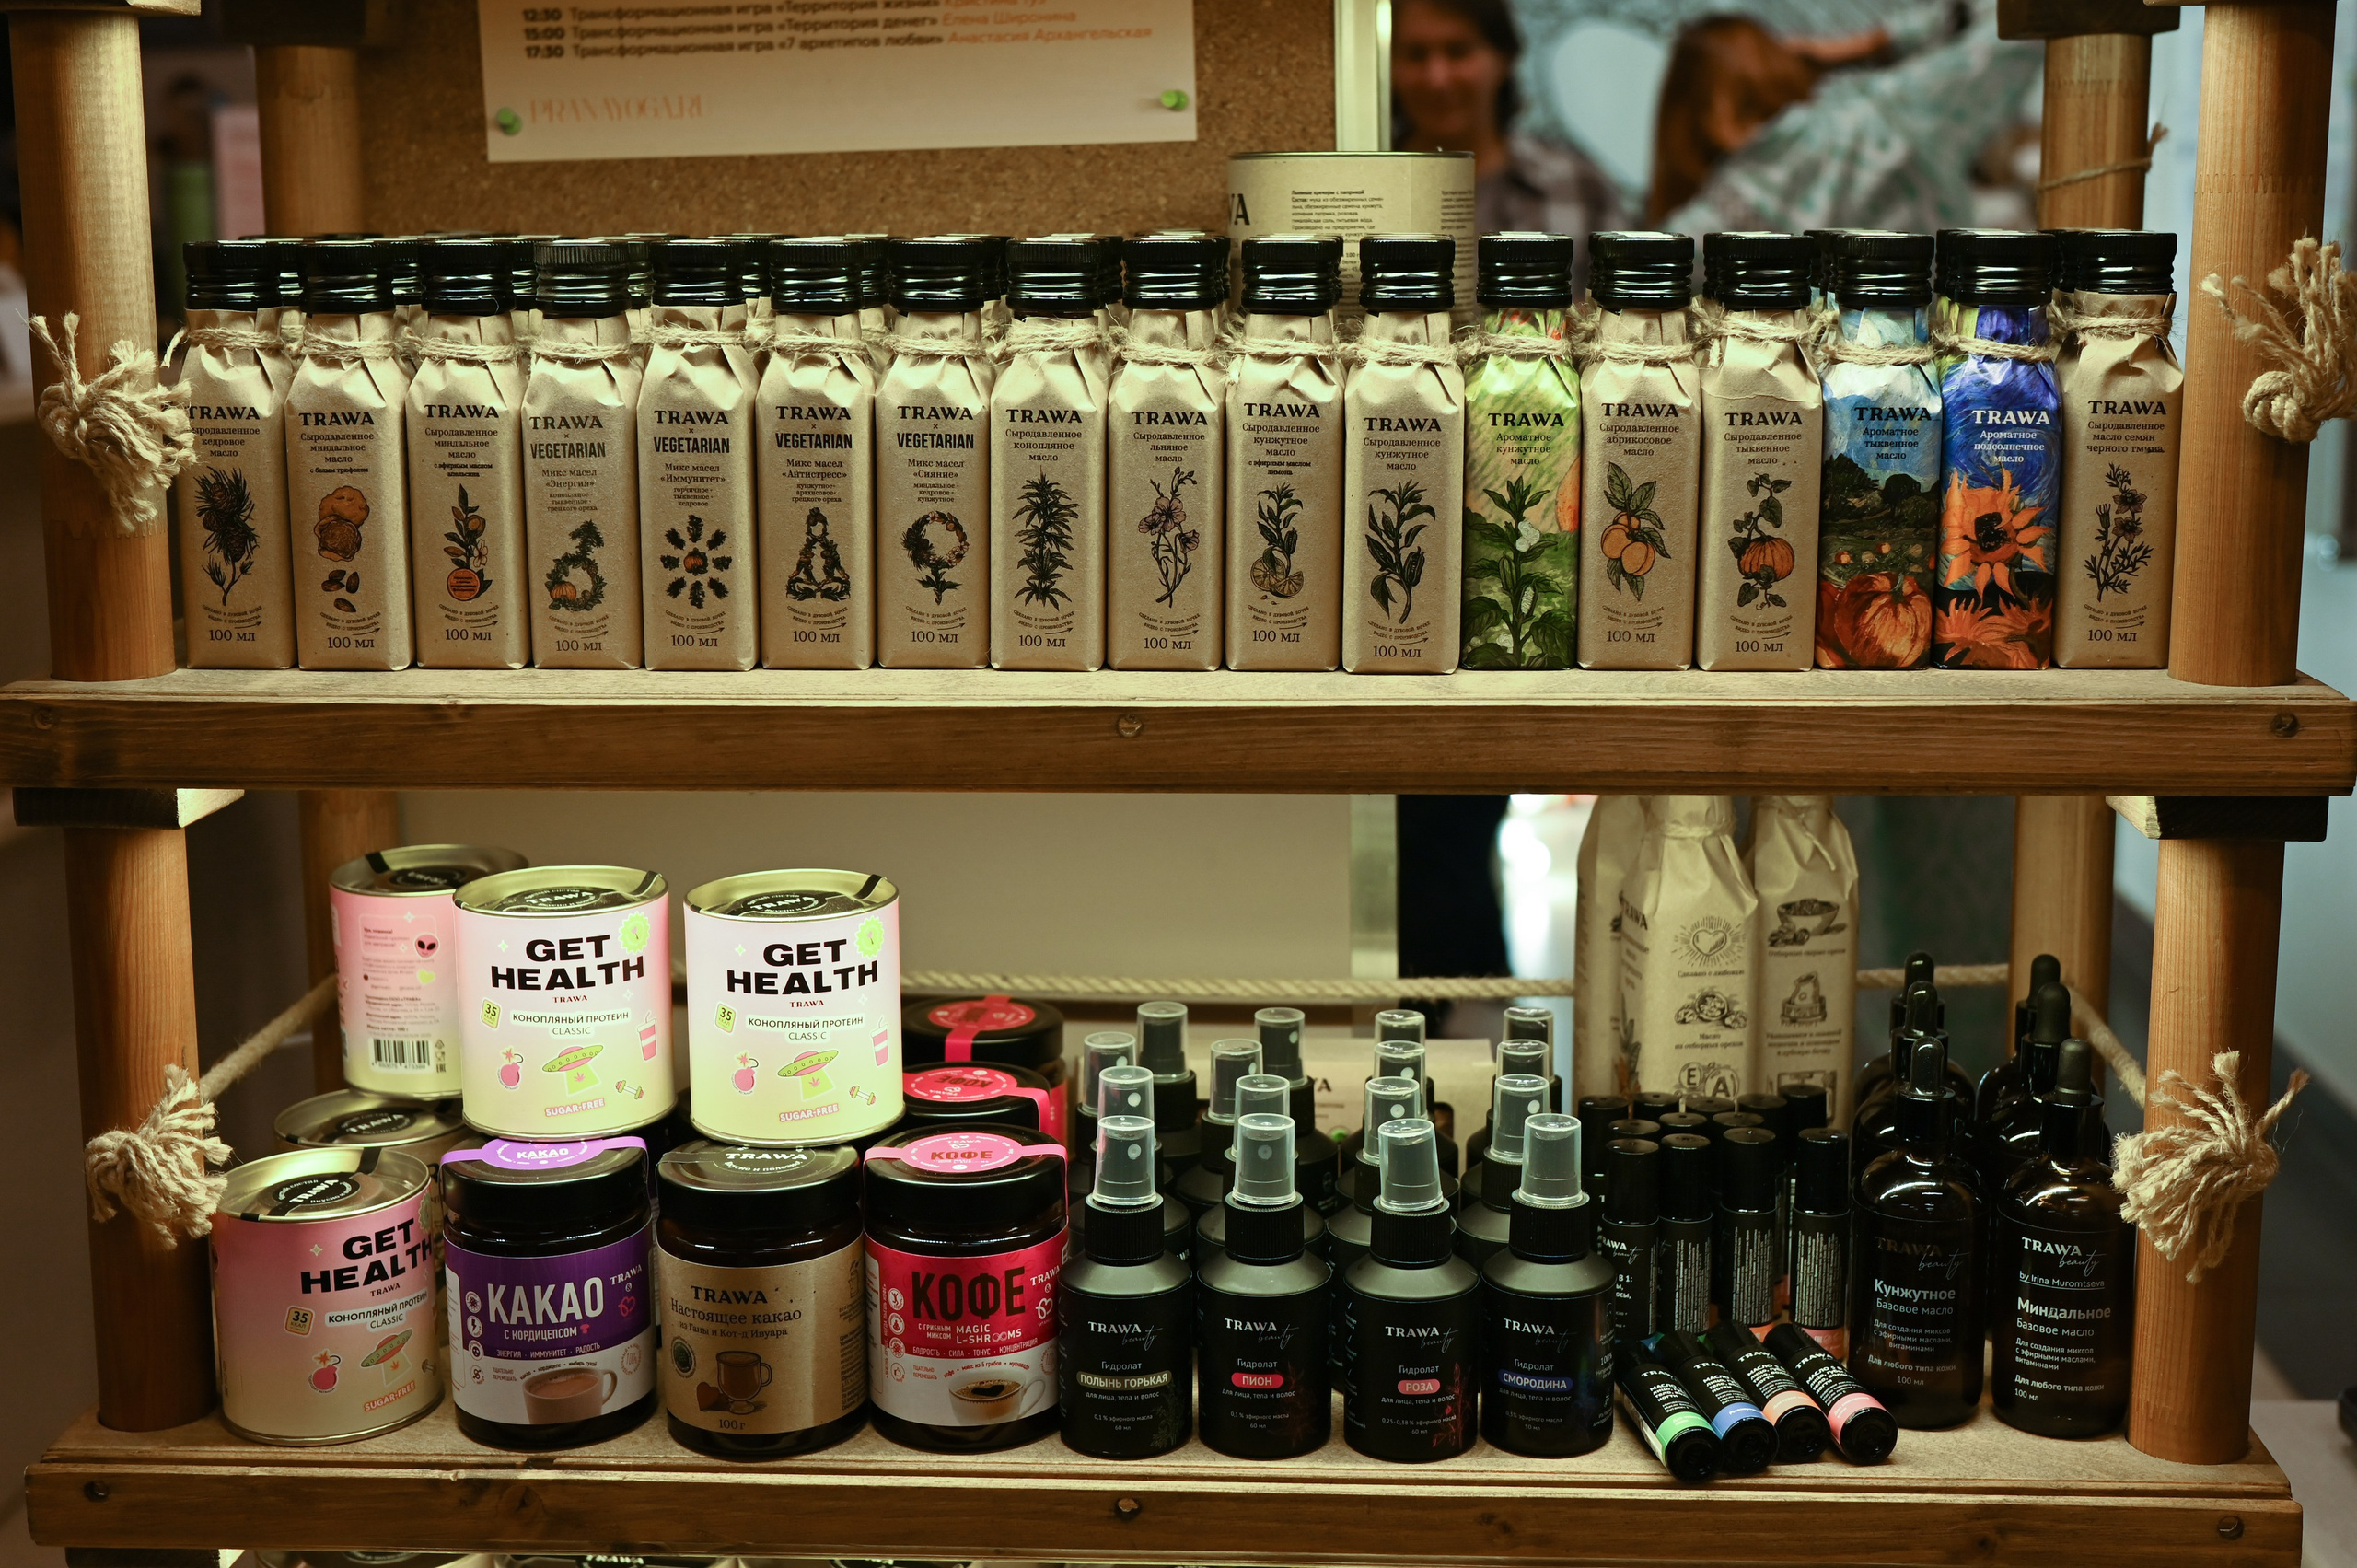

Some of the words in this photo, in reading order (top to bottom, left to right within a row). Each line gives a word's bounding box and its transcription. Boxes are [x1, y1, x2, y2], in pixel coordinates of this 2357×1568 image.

[186, 406, 260, 420] TRAWA
[424, 404, 499, 418] TRAWA
[775, 406, 851, 420] TRAWA
[897, 406, 974, 420] TRAWA
[1244, 403, 1320, 417] TRAWA
[1601, 403, 1678, 417] TRAWA
[1854, 407, 1932, 421] TRAWA
[2088, 401, 2166, 415] TRAWA
[299, 412, 375, 425] TRAWA
[529, 415, 603, 429] TRAWA
[654, 411, 729, 424] TRAWA
[1005, 409, 1082, 423] TRAWA
[1132, 412, 1208, 425] TRAWA
[1488, 413, 1564, 427] TRAWA
[1725, 412, 1803, 425] TRAWA
[1972, 410, 2050, 424] TRAWA
[1242, 423, 1319, 433] Сыродавленное
[1364, 417, 1442, 432] TRAWA
[1600, 423, 1679, 434] Сыродавленное
[2088, 422, 2165, 432] Сыродавленное
[190, 427, 260, 436] ыродавленное
[300, 432, 374, 442] Сыродавленное
[424, 428, 498, 438] Сыродавленное
[1005, 429, 1082, 439] Сыродавленное
[1133, 432, 1205, 441] Сыродавленное
[1496, 433, 1551, 442] Ароматное
[1863, 427, 1918, 436] Ароматное
[1980, 430, 2037, 440] Ароматное
[2093, 433, 2121, 441] масло
[2125, 434, 2155, 442] семян
[202, 438, 245, 447] кедровое
[654, 437, 729, 453] VEGETARIAN
[775, 433, 853, 449] VEGETARIAN
[897, 433, 974, 449] VEGETARIAN
[1014, 441, 1074, 450] конопляное
[1253, 436, 1308, 446] кунжутное
[1364, 438, 1440, 447] Сыродавленное
[1607, 436, 1672, 445] абрикосовое
[310, 444, 366, 452] миндальное
[530, 443, 606, 459] VEGETARIAN
[1150, 444, 1188, 452] льняное
[1265, 447, 1295, 457] масло
[1496, 445, 1550, 454] кунжутное
[1736, 445, 1790, 453] тыквенное
[1974, 443, 2045, 452] подсолнечное
[2086, 445, 2129, 454] черного
[325, 455, 353, 463] масло
[448, 450, 476, 459] масло
[1029, 453, 1058, 461] масло
[1375, 450, 1429, 459] кунжутное
[1747, 457, 1778, 465] масло
[665, 463, 690, 471] Микс
[692, 464, 720, 472] масел
[661, 474, 726, 483] «Иммунитет»
[782, 470, 847, 479] «Антистресс»
[913, 470, 958, 479] «Сияние»
[545, 480, 595, 488] «Энергия»
[671, 634, 694, 646] 100
[699, 637, 717, 646] мл
[2088, 629, 2112, 641] 100
[2117, 631, 2137, 642] мл
[526, 935, 610, 962] GET
[763, 939, 846, 967] GET
[492, 956, 644, 990] HEALTH
[727, 960, 877, 995] HEALTH
[513, 1014, 584, 1023] КОНОПЛЯНЫЙ
[586, 1012, 629, 1022] ПРОТЕИН
[749, 1018, 819, 1028] КОНОПЛЯНЫЙ
[822, 1017, 863, 1028] ПРОТЕИН
[517, 1148, 569, 1159] КАКАО
[726, 1152, 807, 1160] TRAWA
[931, 1151, 993, 1160] КОФЕ
[343, 1218, 414, 1260] GET
[2022, 1237, 2082, 1256] TRAWA
[301, 1237, 432, 1294] HEALTH
[610, 1264, 643, 1285] TRAWA
[2031, 1274, 2049, 1284] Irina
[2052, 1278, 2105, 1287] Muromtseva
[370, 1283, 401, 1296] TRAWA
[691, 1286, 768, 1304] TRAWA
[911, 1266, 1026, 1321] КОФЕ
[1875, 1279, 1956, 1302] Кунжутное
[329, 1304, 398, 1323] КОНОПЛЯНЫЙ
[400, 1292, 427, 1311] ПРОТЕИН
[488, 1277, 604, 1325] КАКАО
[1876, 1298, 1919, 1314] Базовое
[1922, 1307, 1954, 1315] масло
[671, 1298, 747, 1326] Настоящее
[752, 1309, 802, 1324] какао
[2018, 1296, 2110, 1320] Миндальное
[370, 1314, 403, 1329] CLASSIC
[1088, 1322, 1142, 1333] TRAWA
[1225, 1318, 1277, 1331] TRAWA
[1504, 1318, 1554, 1334] TRAWA
[2016, 1318, 2059, 1335] Базовое
[2062, 1328, 2094, 1337] масло
[512, 1327, 577, 1342] КОРДИЦЕПСОМ
[689, 1323, 709, 1334] Ганы
[957, 1324, 990, 1333] MAGIC
[1385, 1326, 1439, 1337] TRAWA
[496, 1350, 521, 1358] ЭНЕРГИЯ
[530, 1349, 566, 1358] ИММУНИТЕТ
[576, 1343, 600, 1353] РАДОСТЬ
[912, 1346, 940, 1356] БОДРОСТЬ
[973, 1348, 990, 1356] ТОНУС
[1000, 1338, 1038, 1353] КОНЦЕНТРАЦИЯ
[1101, 1361, 1142, 1371] Гидролат
[1237, 1359, 1278, 1368] Гидролат
[1080, 1375, 1121, 1388] ПОЛЫНЬ
[1125, 1374, 1167, 1388] ГОРЬКАЯ
[1243, 1376, 1272, 1386] ПИОН
[1406, 1383, 1433, 1391] РОЗА
[1503, 1373, 1567, 1389] СМОРОДИНА
[2015, 1375, 2029, 1385] Для
[2031, 1378, 2061, 1391] любого
[720, 1420, 738, 1429] 100
